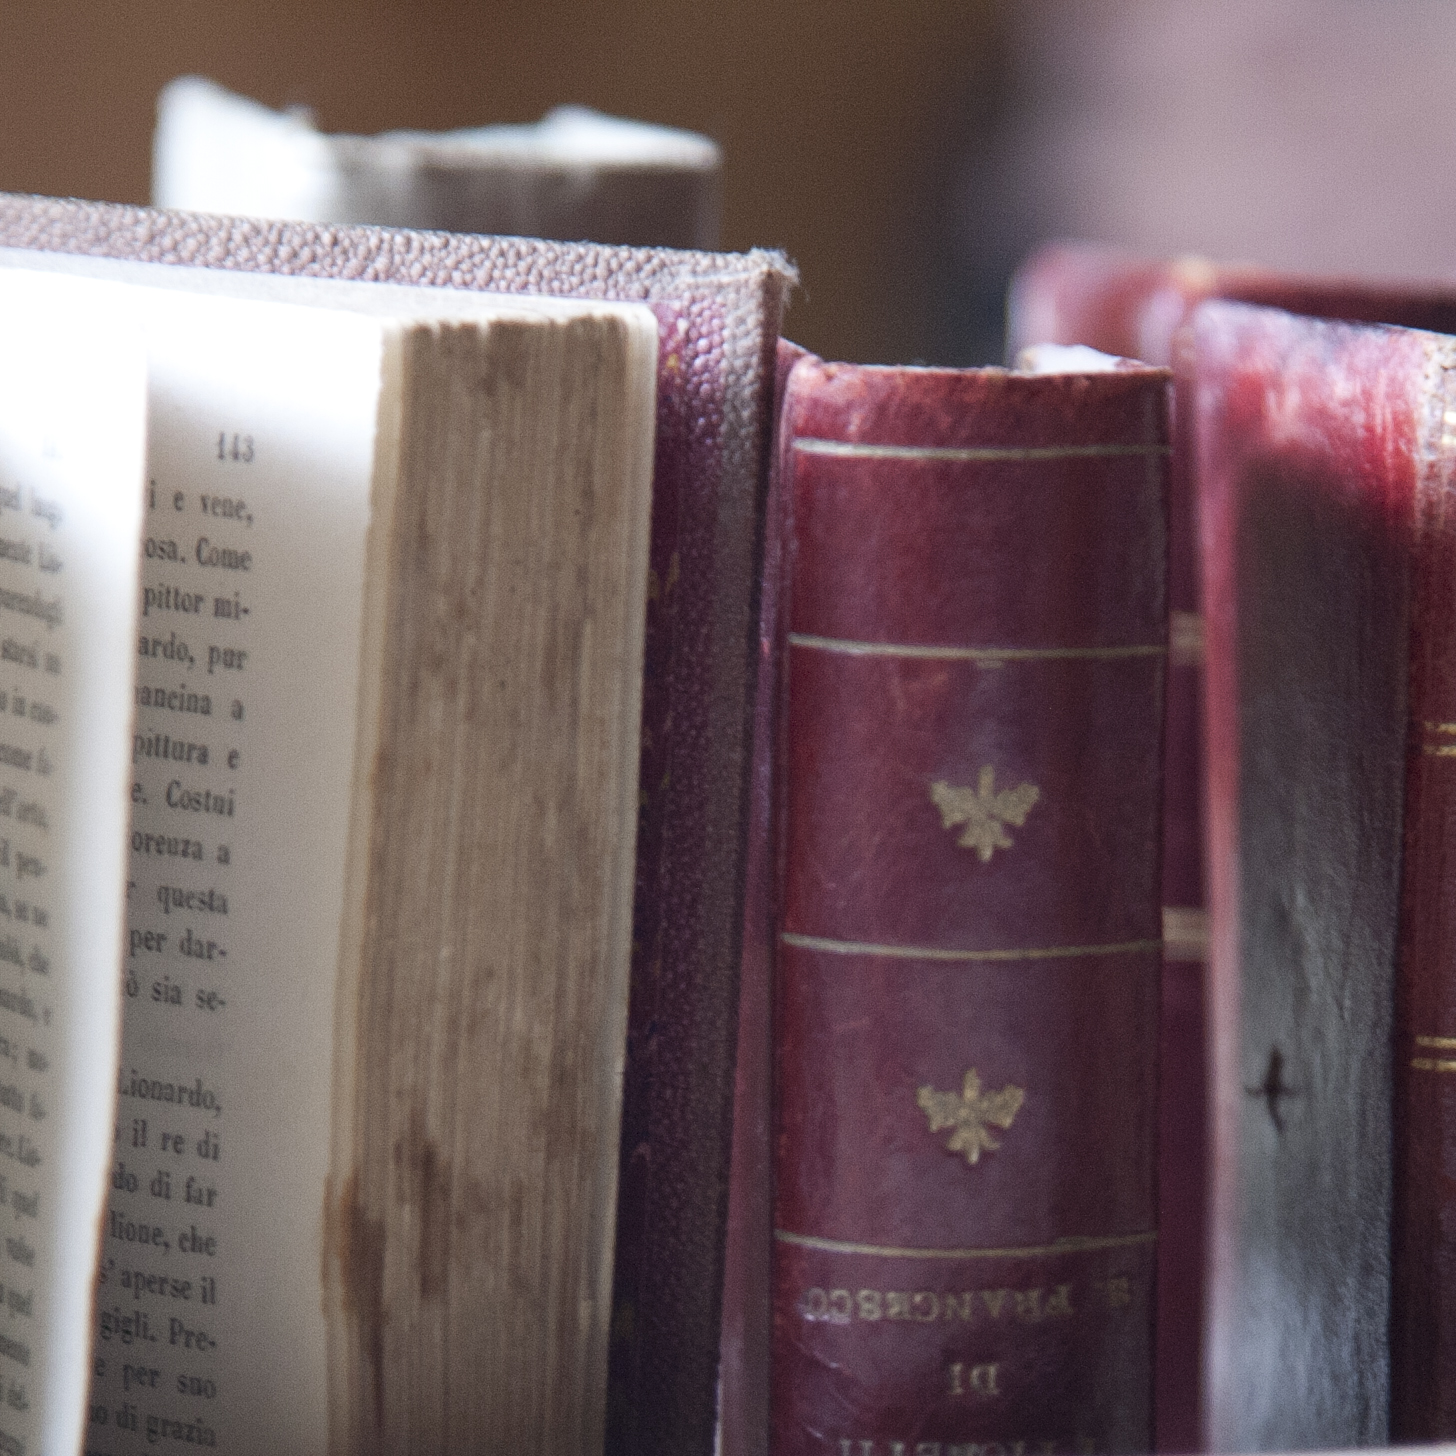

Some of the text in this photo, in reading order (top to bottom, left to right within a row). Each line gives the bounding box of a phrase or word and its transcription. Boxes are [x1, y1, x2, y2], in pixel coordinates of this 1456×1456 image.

[195, 536, 253, 571] Come
[196, 1128, 220, 1162] di
[948, 1362, 1001, 1397] DI
